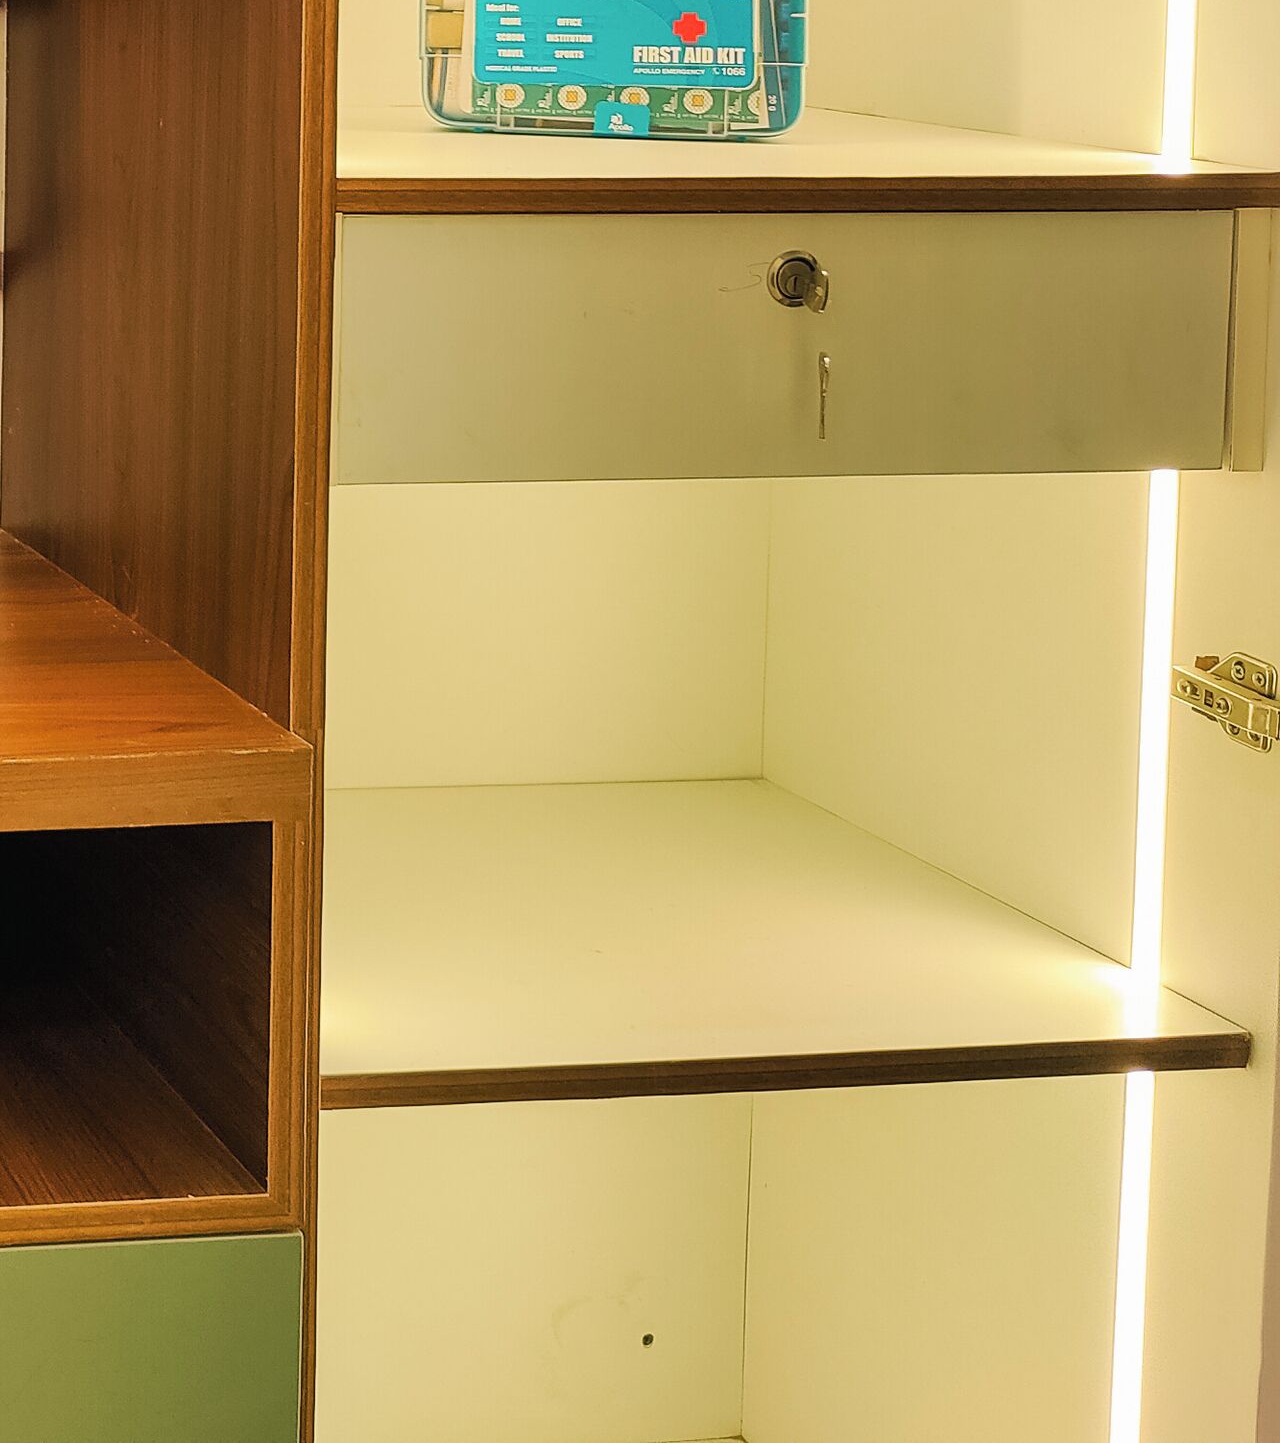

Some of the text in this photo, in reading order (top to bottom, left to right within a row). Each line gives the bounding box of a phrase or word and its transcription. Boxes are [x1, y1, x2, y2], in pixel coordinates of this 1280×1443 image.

[556, 18, 583, 27] OFFICE
[546, 34, 593, 43] INSTITUTION
[554, 49, 584, 59] SPORTS
[633, 46, 746, 64] FIRST AID KIT
[721, 68, 746, 76] 1066
